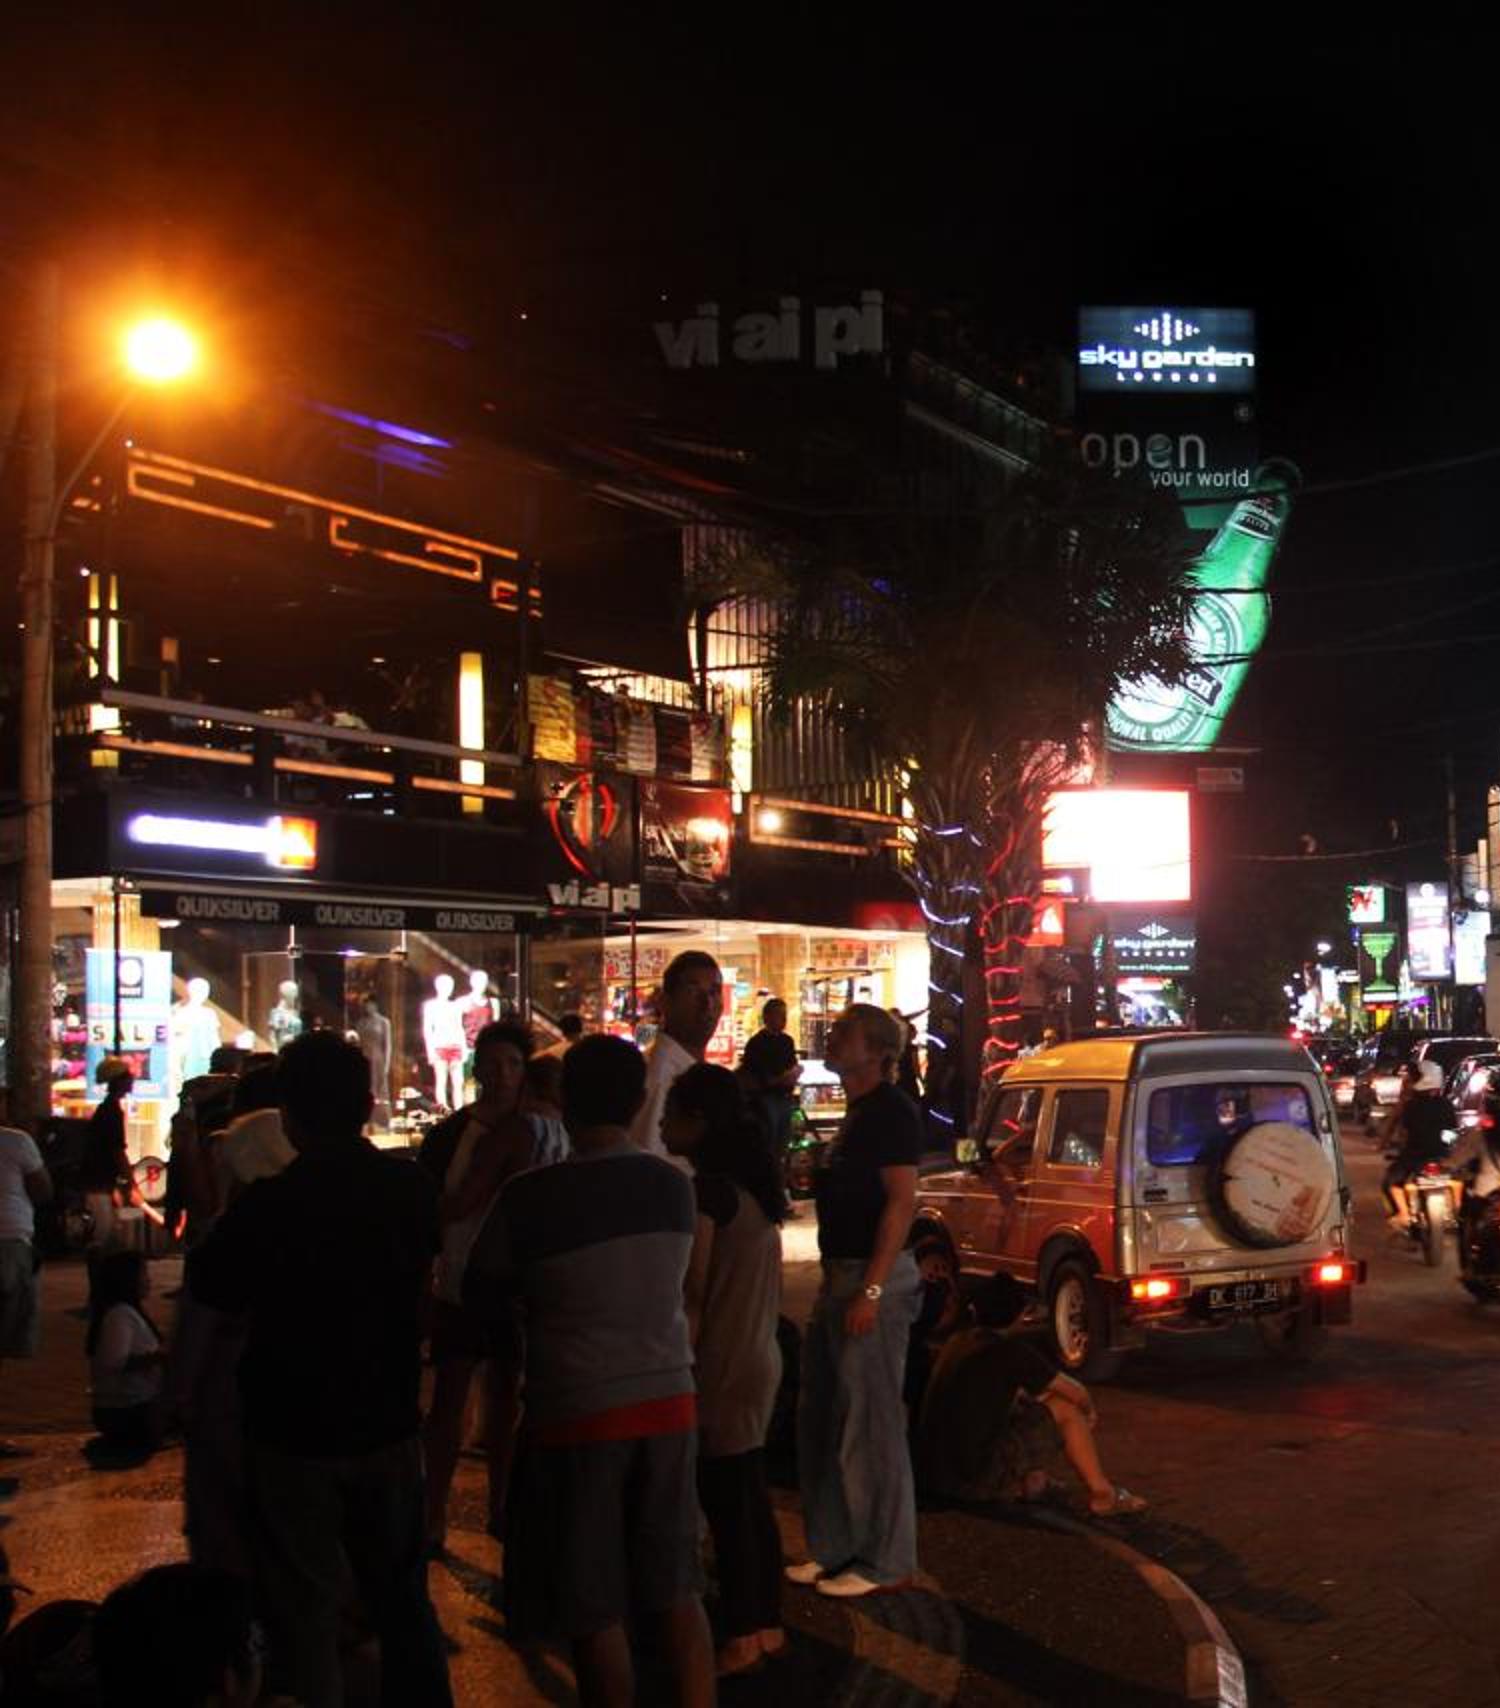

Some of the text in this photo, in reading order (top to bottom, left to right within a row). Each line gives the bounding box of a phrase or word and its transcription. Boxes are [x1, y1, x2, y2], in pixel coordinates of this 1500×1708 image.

[1079, 345, 1255, 369] sky garden
[1081, 433, 1206, 476] open
[1150, 469, 1249, 488] your world
[176, 895, 279, 922] QUIKSILVER
[316, 903, 406, 928] QUIKSILVER
[436, 911, 516, 931] QUIKSILVER
